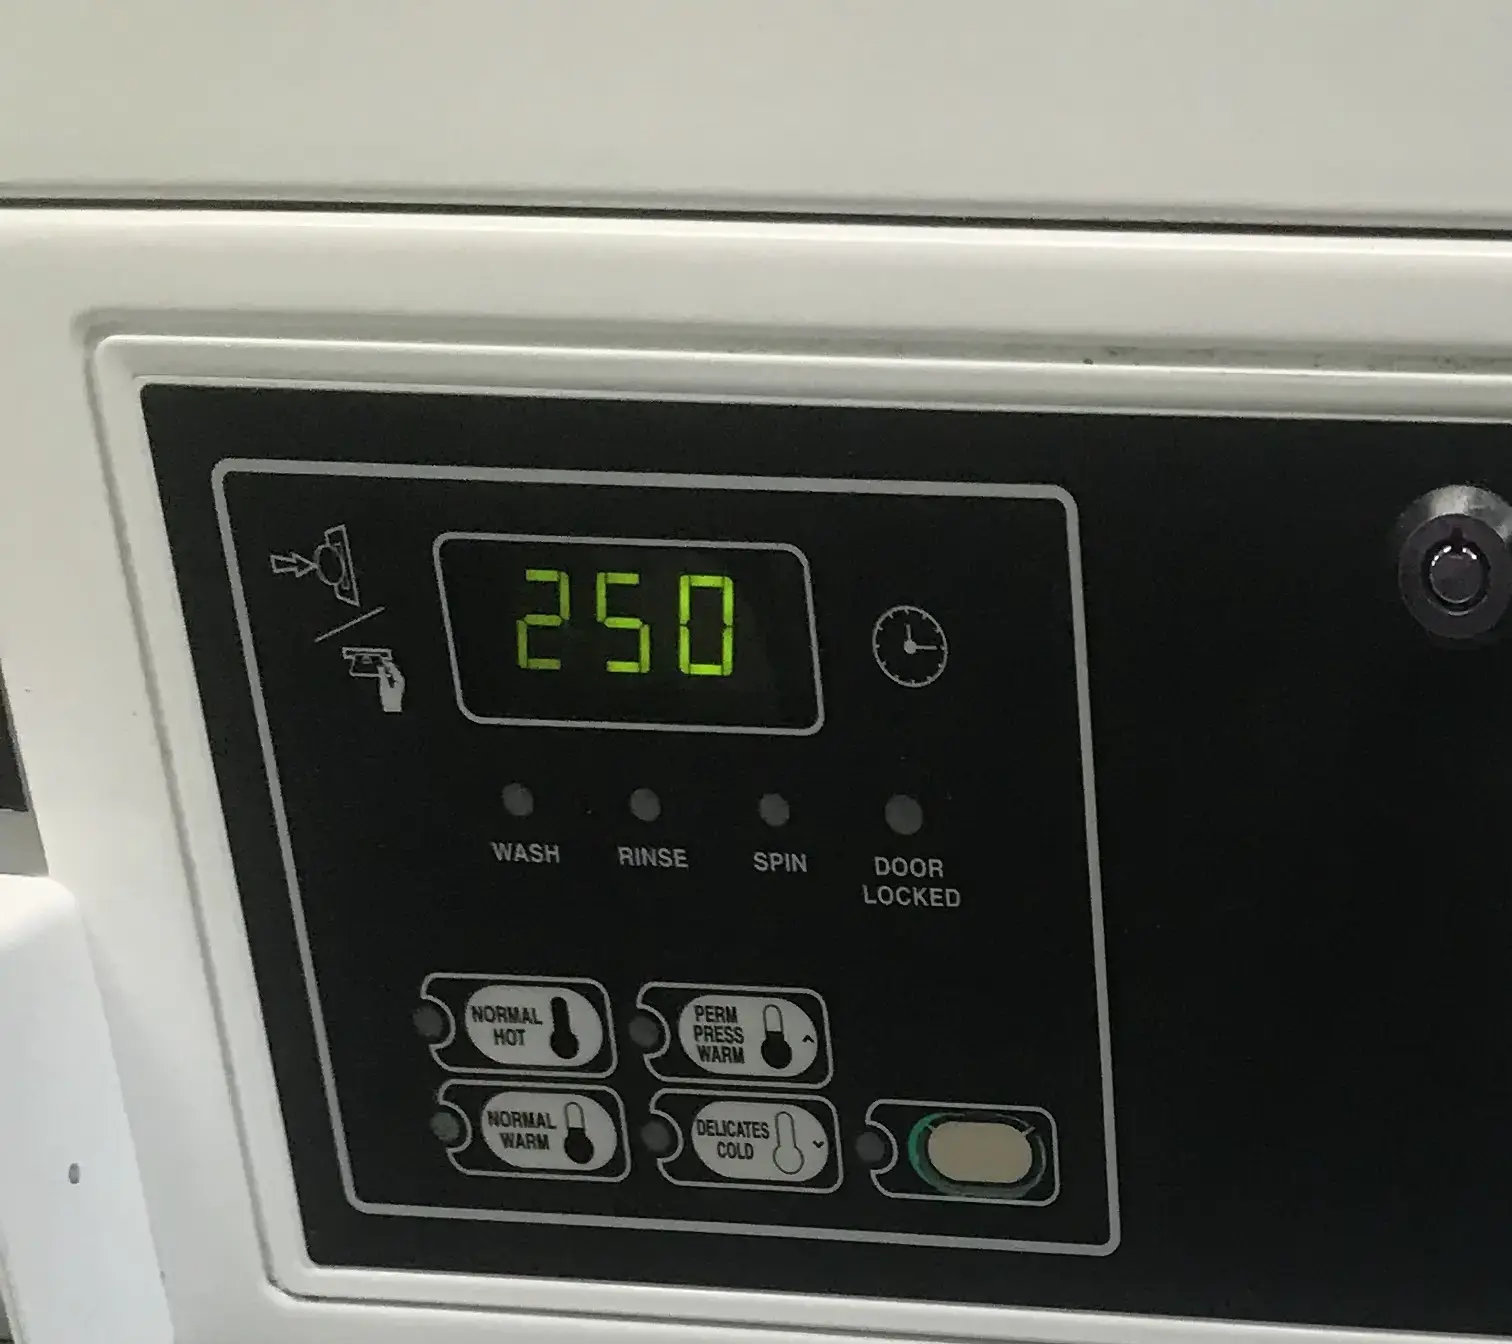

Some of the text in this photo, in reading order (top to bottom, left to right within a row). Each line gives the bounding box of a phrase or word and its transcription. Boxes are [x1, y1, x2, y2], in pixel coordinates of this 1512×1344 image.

[516, 569, 735, 677] 250
[490, 842, 560, 864] WASH
[618, 846, 690, 868] RINSE
[754, 852, 808, 873] SPIN
[874, 856, 944, 878] DOOR
[862, 884, 961, 908] LOCKED
[471, 1005, 543, 1026] NORMAL
[694, 1005, 738, 1023] PERM
[493, 1028, 526, 1047] HOT
[693, 1025, 745, 1043] PRESS
[697, 1045, 745, 1064] WARM
[488, 1110, 557, 1130] NORMAL
[698, 1118, 770, 1140] DELICATES
[500, 1132, 550, 1150] WARM
[717, 1141, 754, 1160] COLD
